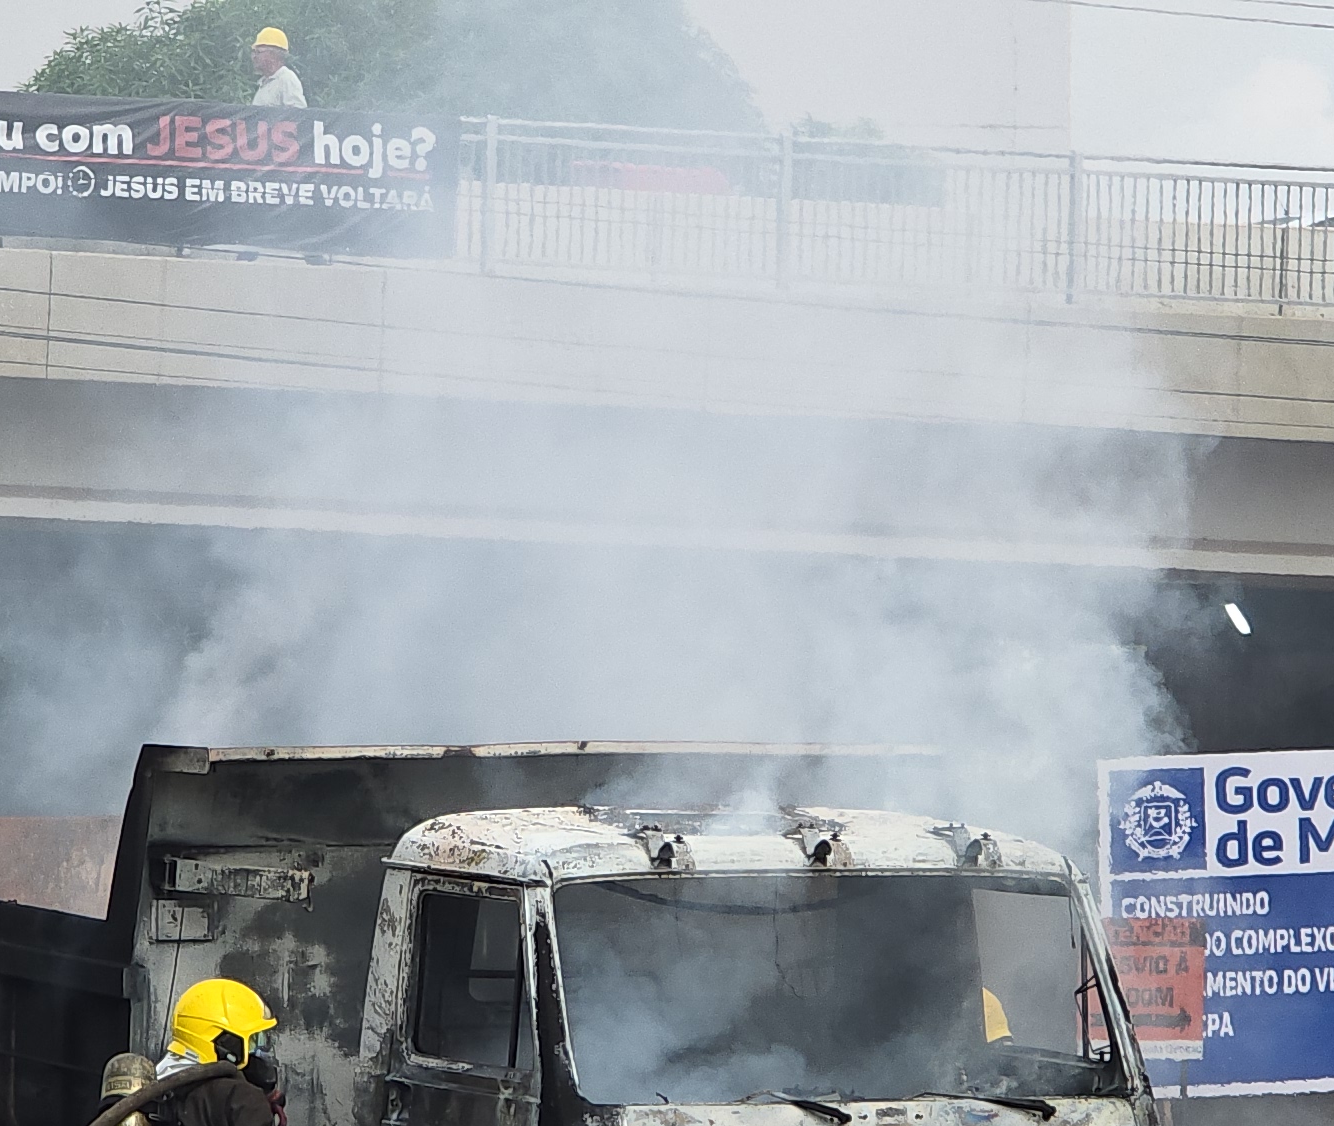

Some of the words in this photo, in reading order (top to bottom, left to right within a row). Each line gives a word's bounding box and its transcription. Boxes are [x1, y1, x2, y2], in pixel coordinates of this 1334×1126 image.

[35, 122, 133, 155] com
[146, 115, 300, 163] JESUS
[313, 121, 437, 178] hoje?
[100, 174, 179, 200] JESUS
[185, 178, 225, 203] EM
[230, 180, 315, 206] BREVE
[320, 183, 435, 211] VOLTARÁ
[1215, 820, 1284, 869] de
[1120, 891, 1270, 919] CONSTRUINDO
[1203, 969, 1279, 997] MENTO
[1283, 967, 1311, 994] DO
[1203, 1011, 1234, 1038] PA
